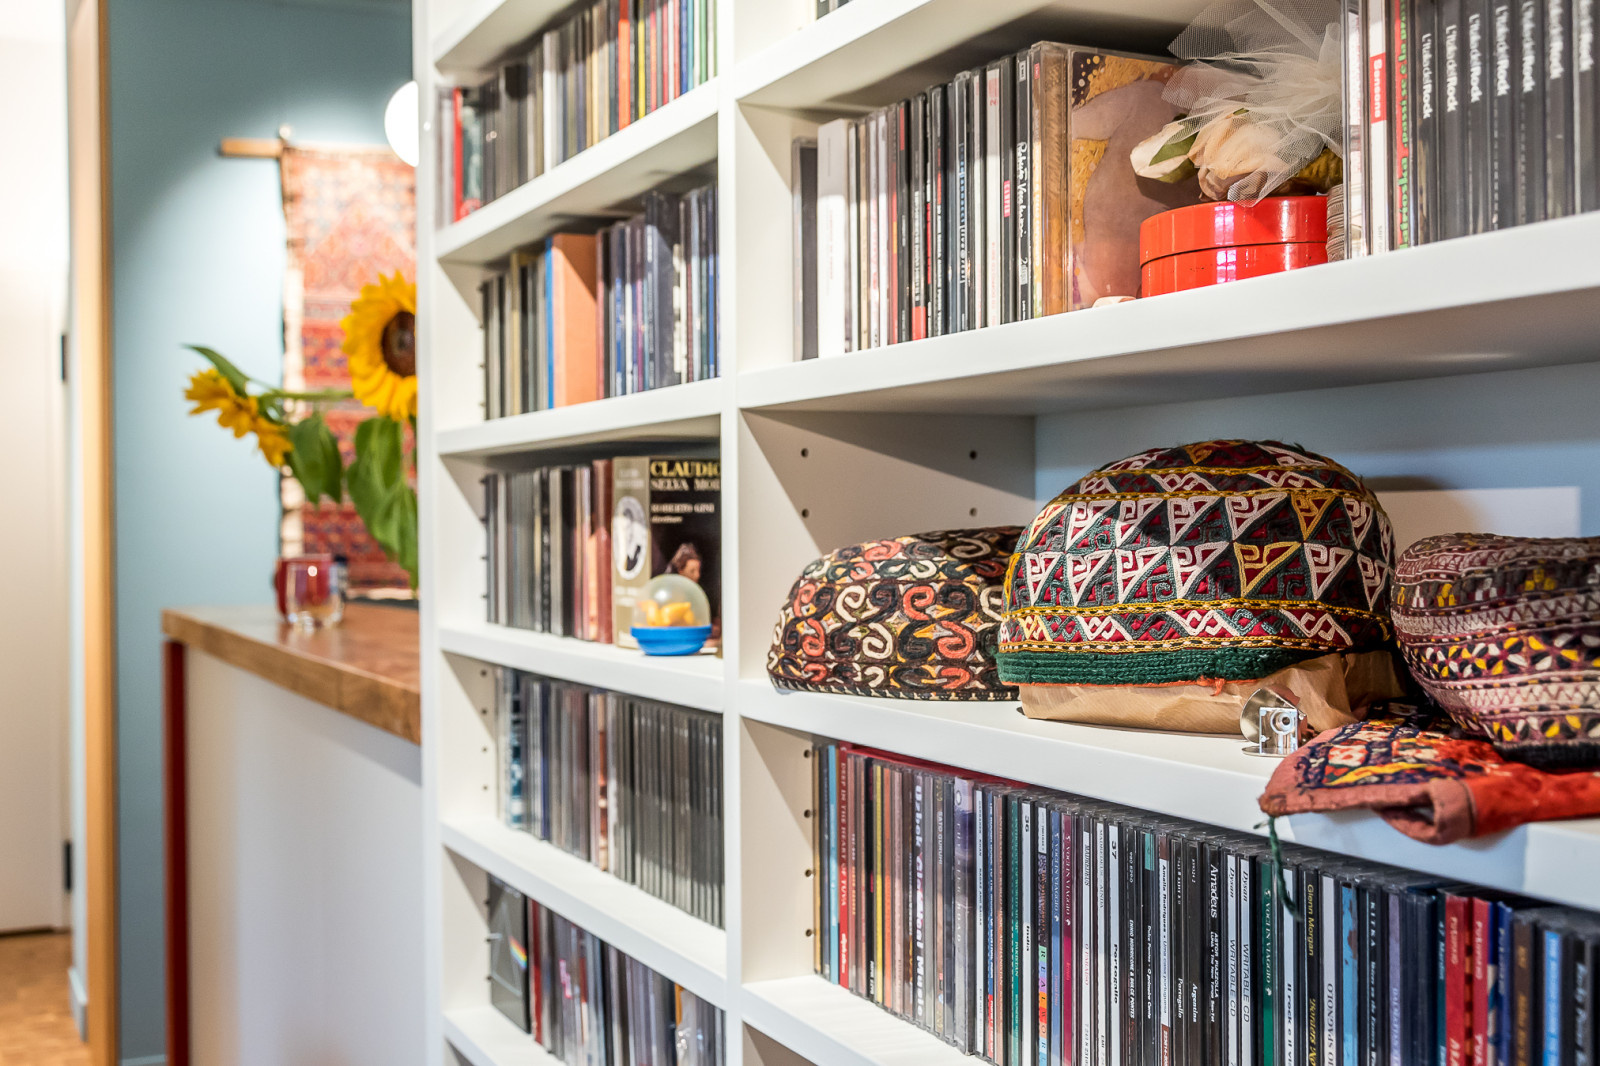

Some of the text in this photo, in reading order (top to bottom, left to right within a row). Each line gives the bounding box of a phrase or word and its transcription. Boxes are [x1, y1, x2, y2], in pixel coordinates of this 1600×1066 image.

[1112, 841, 1117, 860] 37
[1210, 864, 1218, 918] Amadeus
[1266, 928, 1271, 939] IN
[1230, 1000, 1236, 1016] CD
[1243, 1005, 1250, 1022] CD
